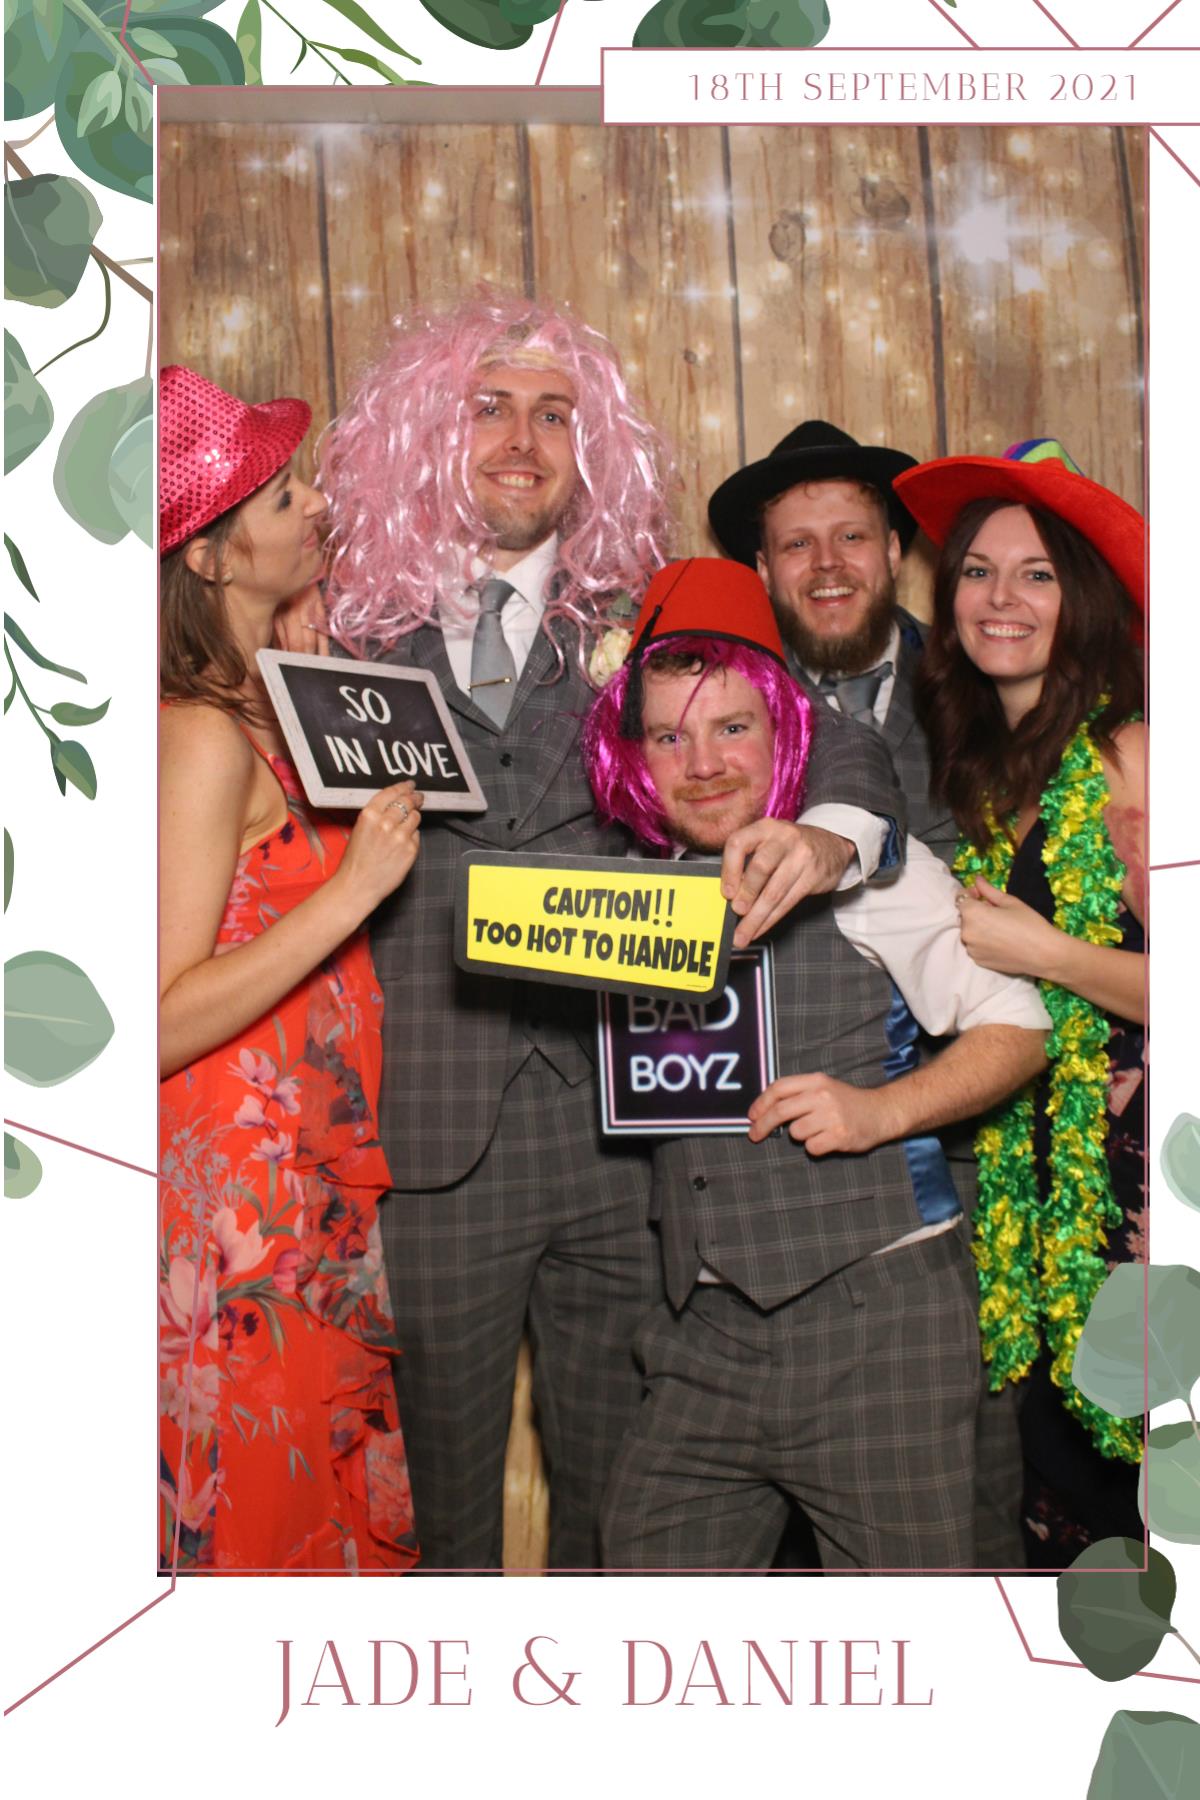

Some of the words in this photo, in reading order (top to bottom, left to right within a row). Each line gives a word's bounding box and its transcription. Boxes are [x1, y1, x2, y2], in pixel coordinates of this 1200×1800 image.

[338, 685, 392, 725] SO
[324, 734, 372, 776] IN
[377, 738, 459, 779] LOVE
[542, 886, 676, 928] CAUTION!!
[473, 918, 522, 947] TOO
[527, 924, 578, 955] HOT
[582, 928, 614, 962] TO
[617, 933, 715, 978] HANDLE
[627, 985, 740, 1033] BAD
[630, 1053, 742, 1092] BOYZ
